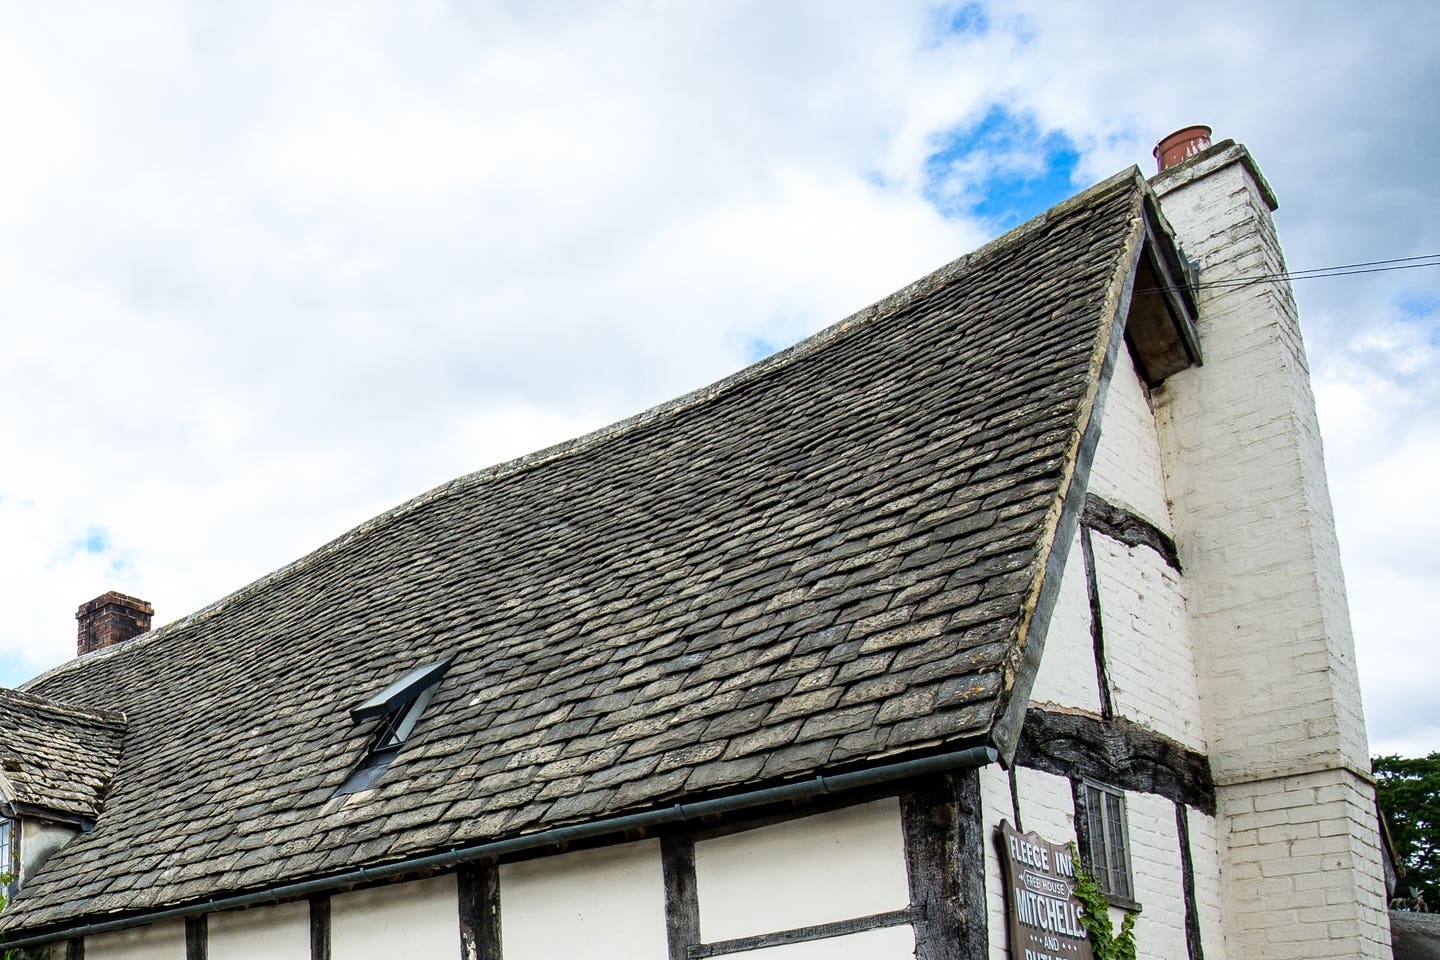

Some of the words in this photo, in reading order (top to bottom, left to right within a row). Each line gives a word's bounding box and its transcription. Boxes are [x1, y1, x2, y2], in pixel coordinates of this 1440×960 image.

[1009, 835, 1050, 871] FLEECE
[1026, 873, 1041, 889] FREE
[1042, 880, 1065, 896] HOUSE
[1015, 887, 1087, 938] MITCHELLS
[1044, 936, 1060, 952] AND
